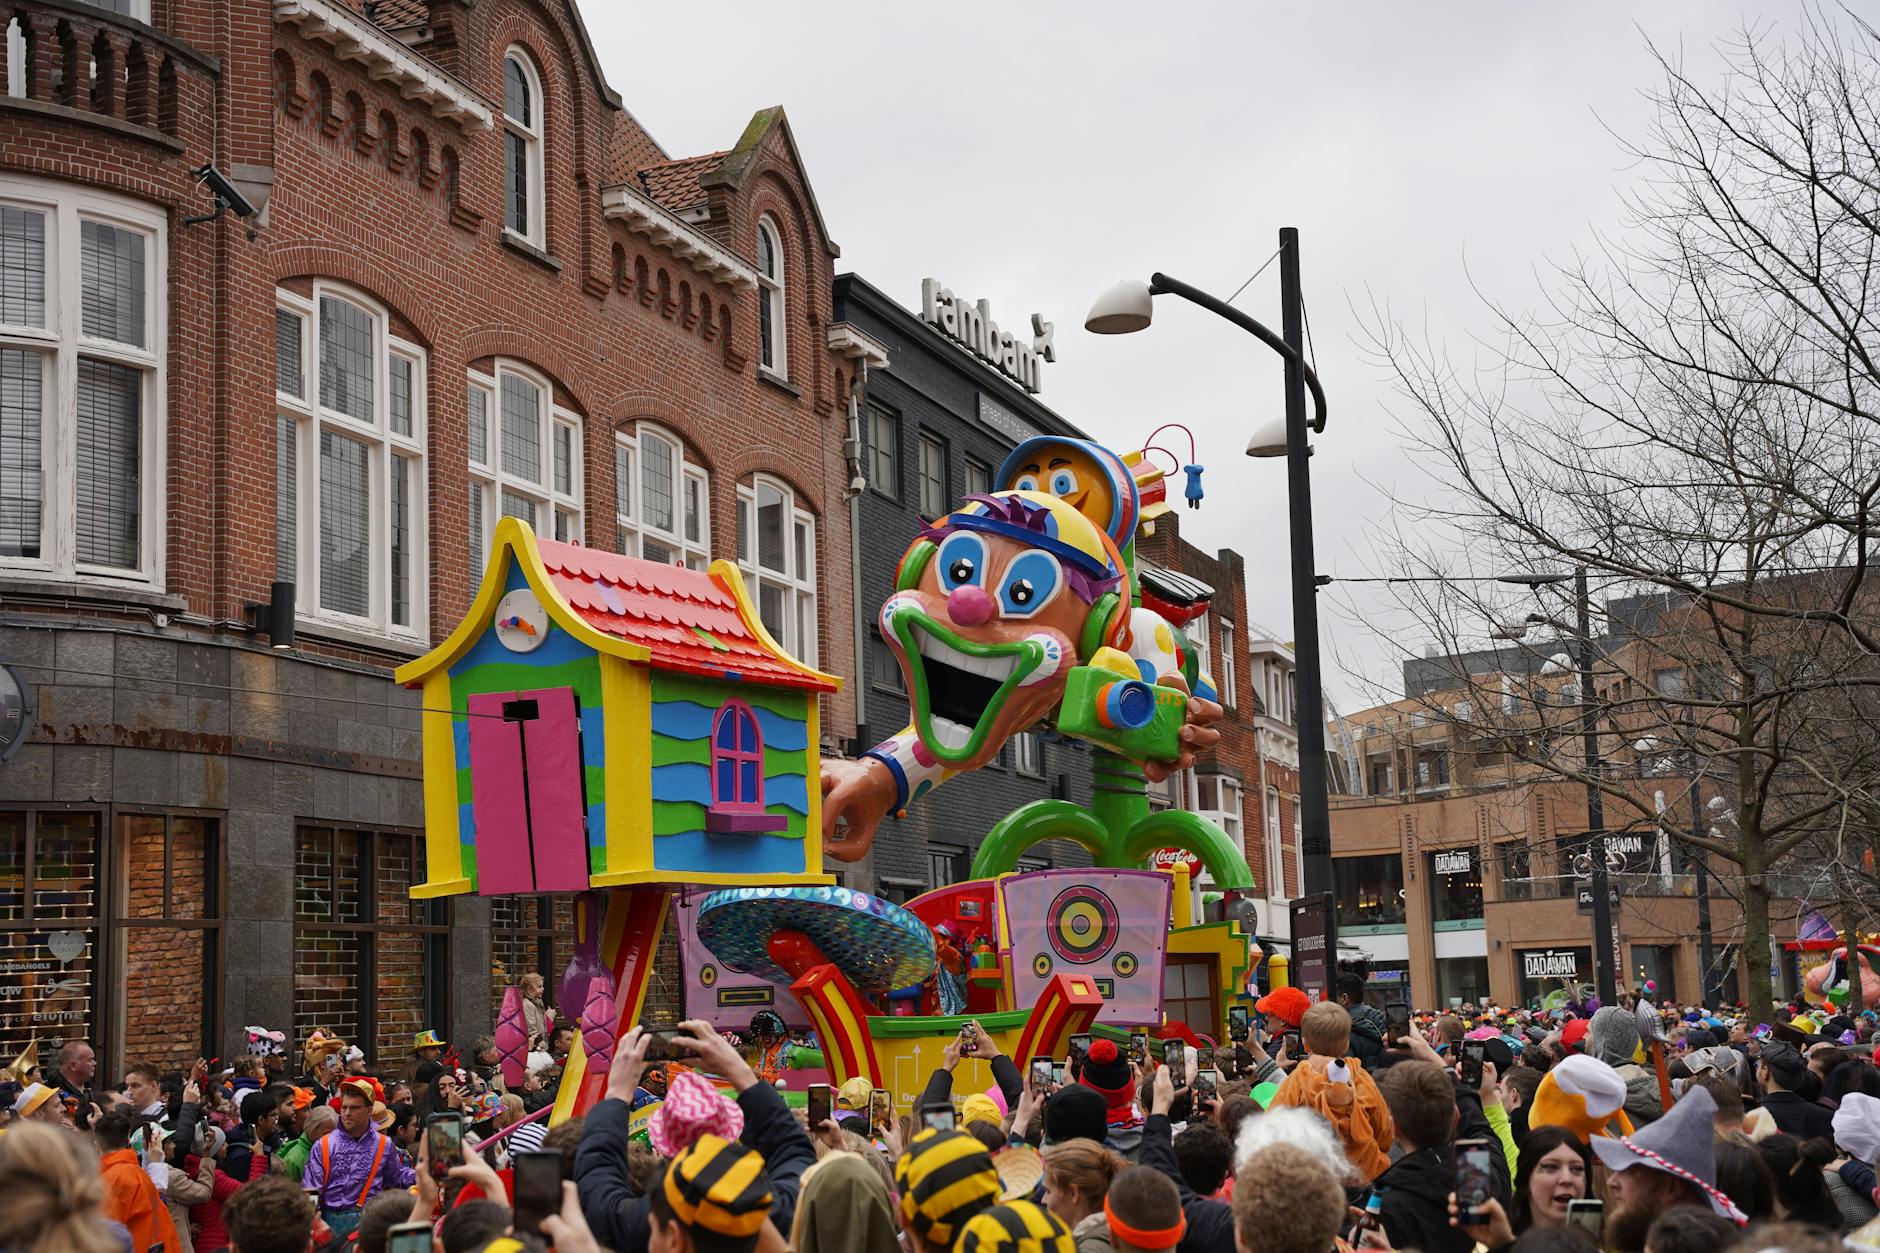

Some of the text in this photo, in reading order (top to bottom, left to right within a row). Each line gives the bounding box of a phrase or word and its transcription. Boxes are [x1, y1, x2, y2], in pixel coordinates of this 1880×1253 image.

[1435, 855, 1470, 871] DADAWAN
[1611, 923, 1621, 970] HEUVEL
[1525, 956, 1576, 976] DADAWAN
